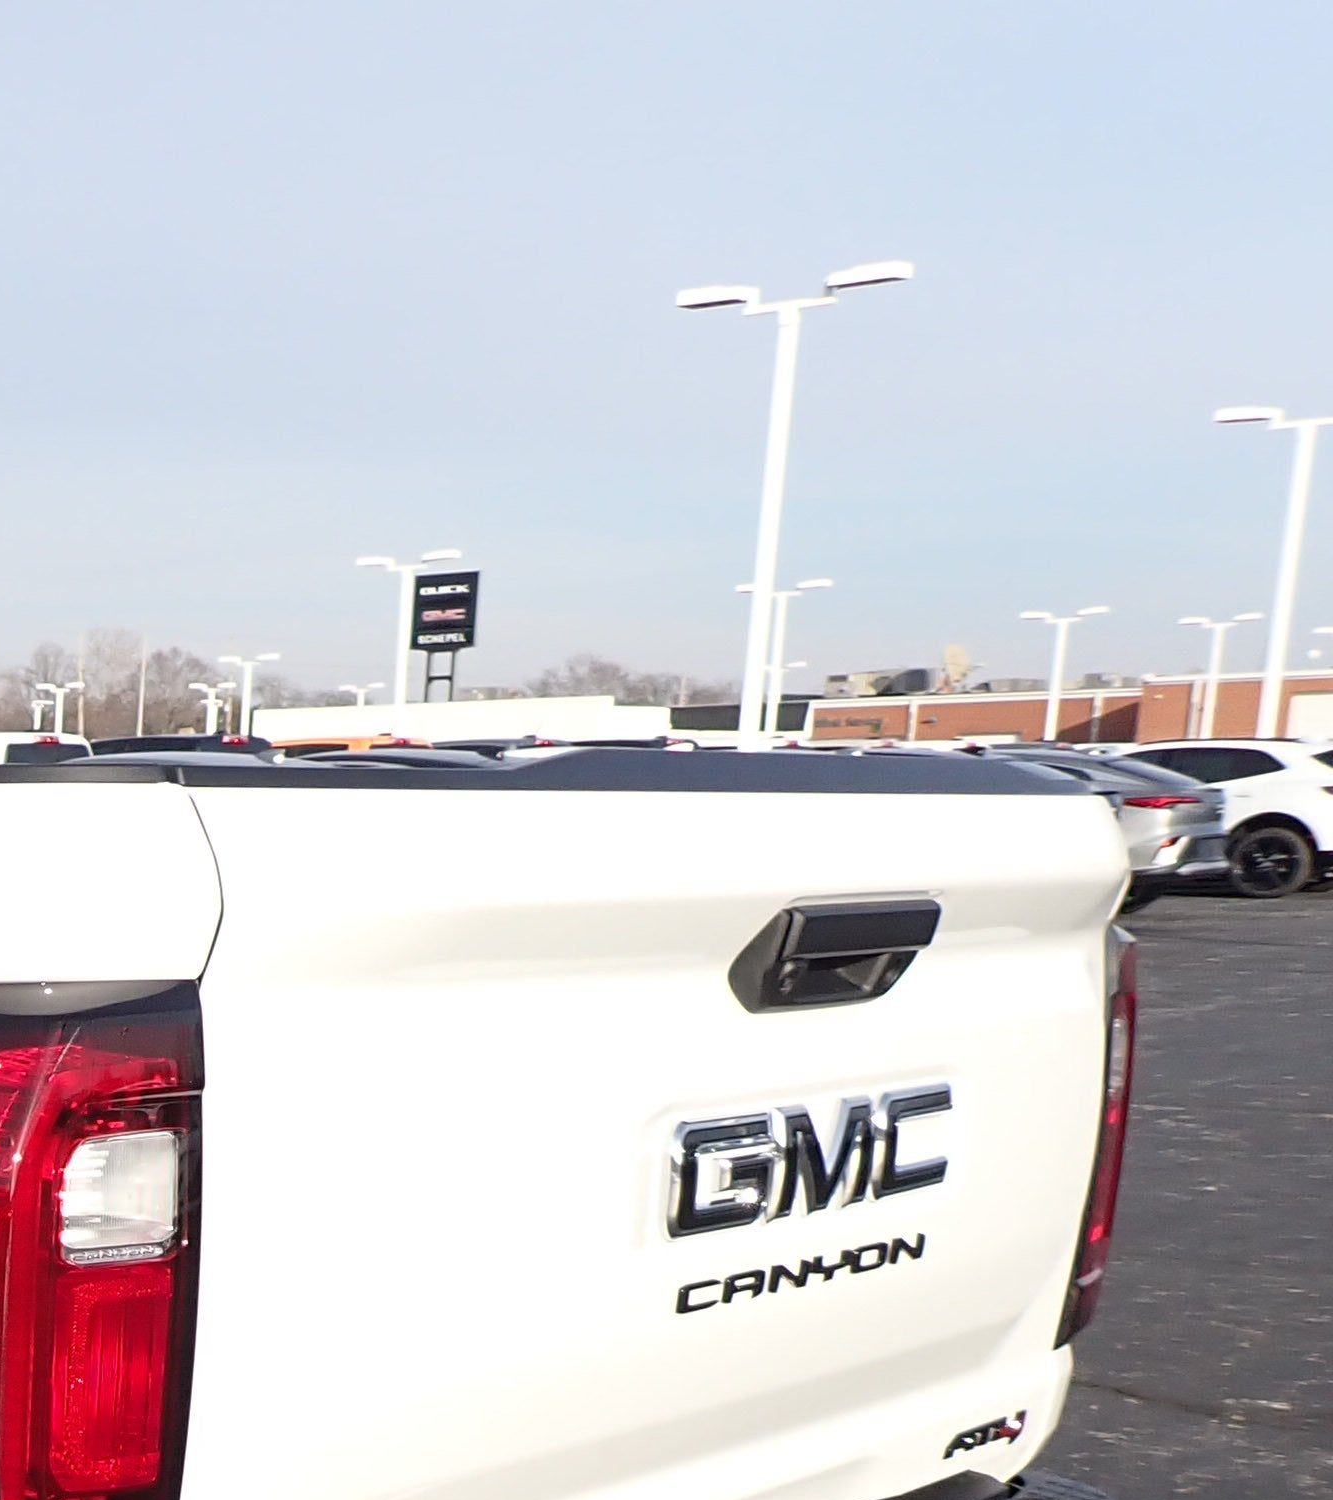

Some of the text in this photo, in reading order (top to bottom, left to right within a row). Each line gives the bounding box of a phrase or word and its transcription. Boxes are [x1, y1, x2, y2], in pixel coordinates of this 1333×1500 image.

[419, 584, 470, 595] BUICK
[422, 608, 466, 621] GMC
[666, 1082, 953, 1240] GMC
[675, 1233, 926, 1314] CANYON
